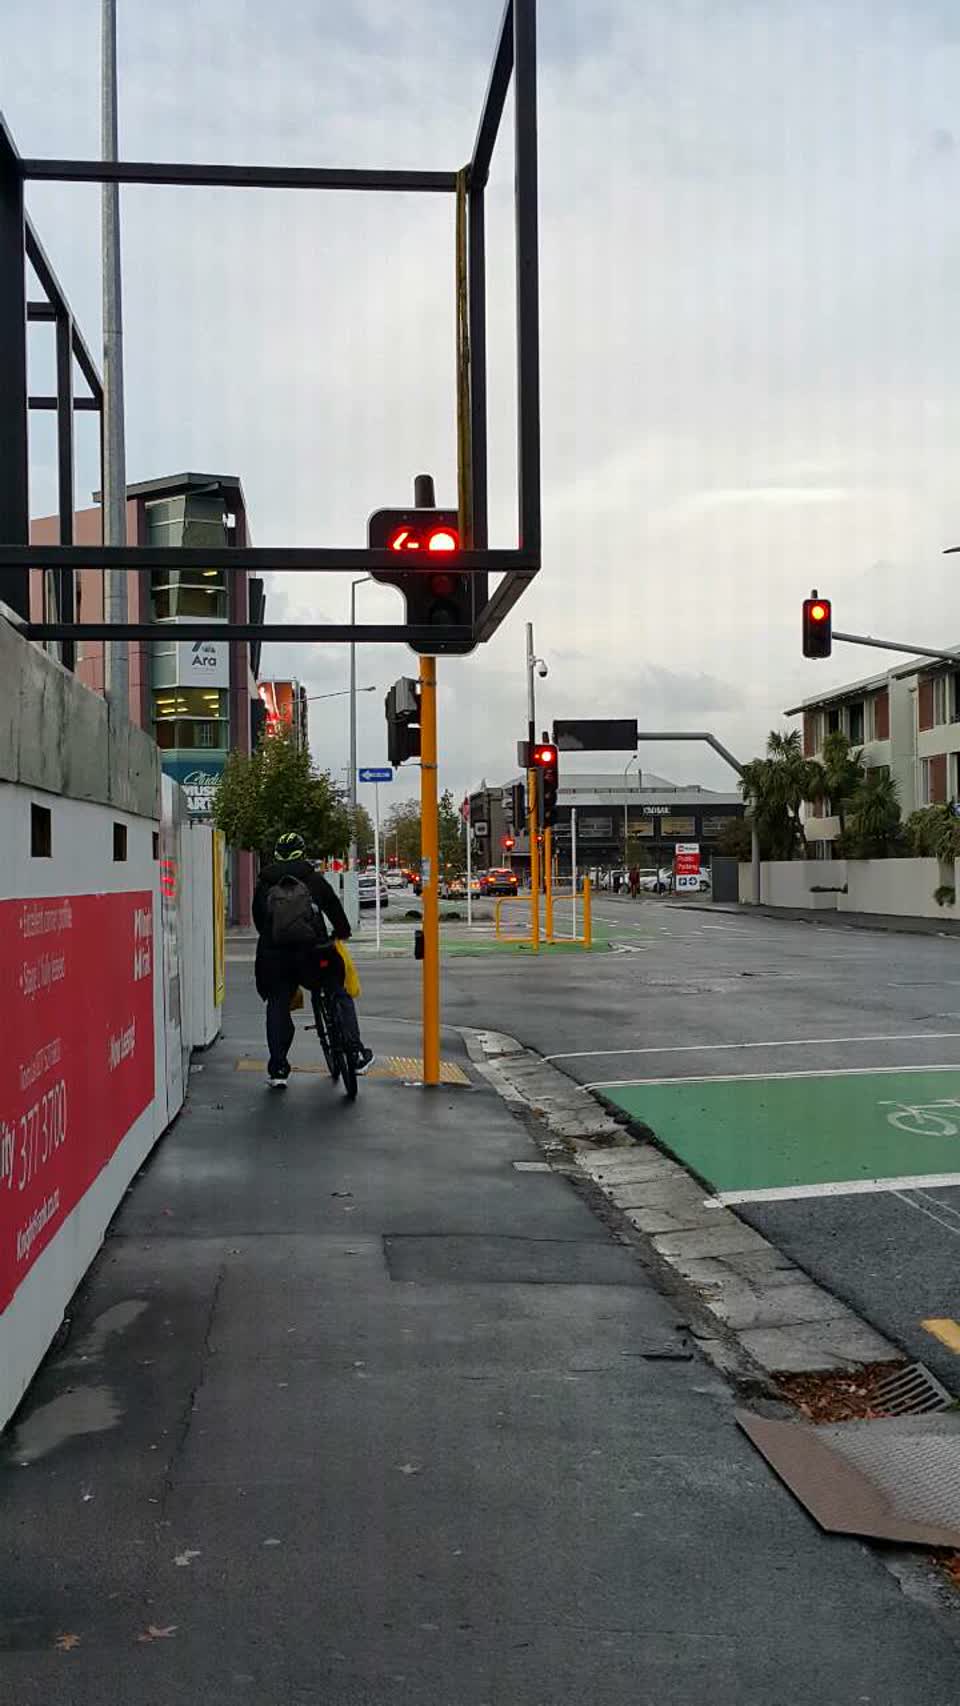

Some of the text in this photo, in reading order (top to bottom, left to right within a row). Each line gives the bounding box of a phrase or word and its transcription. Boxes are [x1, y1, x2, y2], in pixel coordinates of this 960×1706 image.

[192, 655, 216, 666] Ara
[0, 1079, 67, 1191] ity 377 3700
